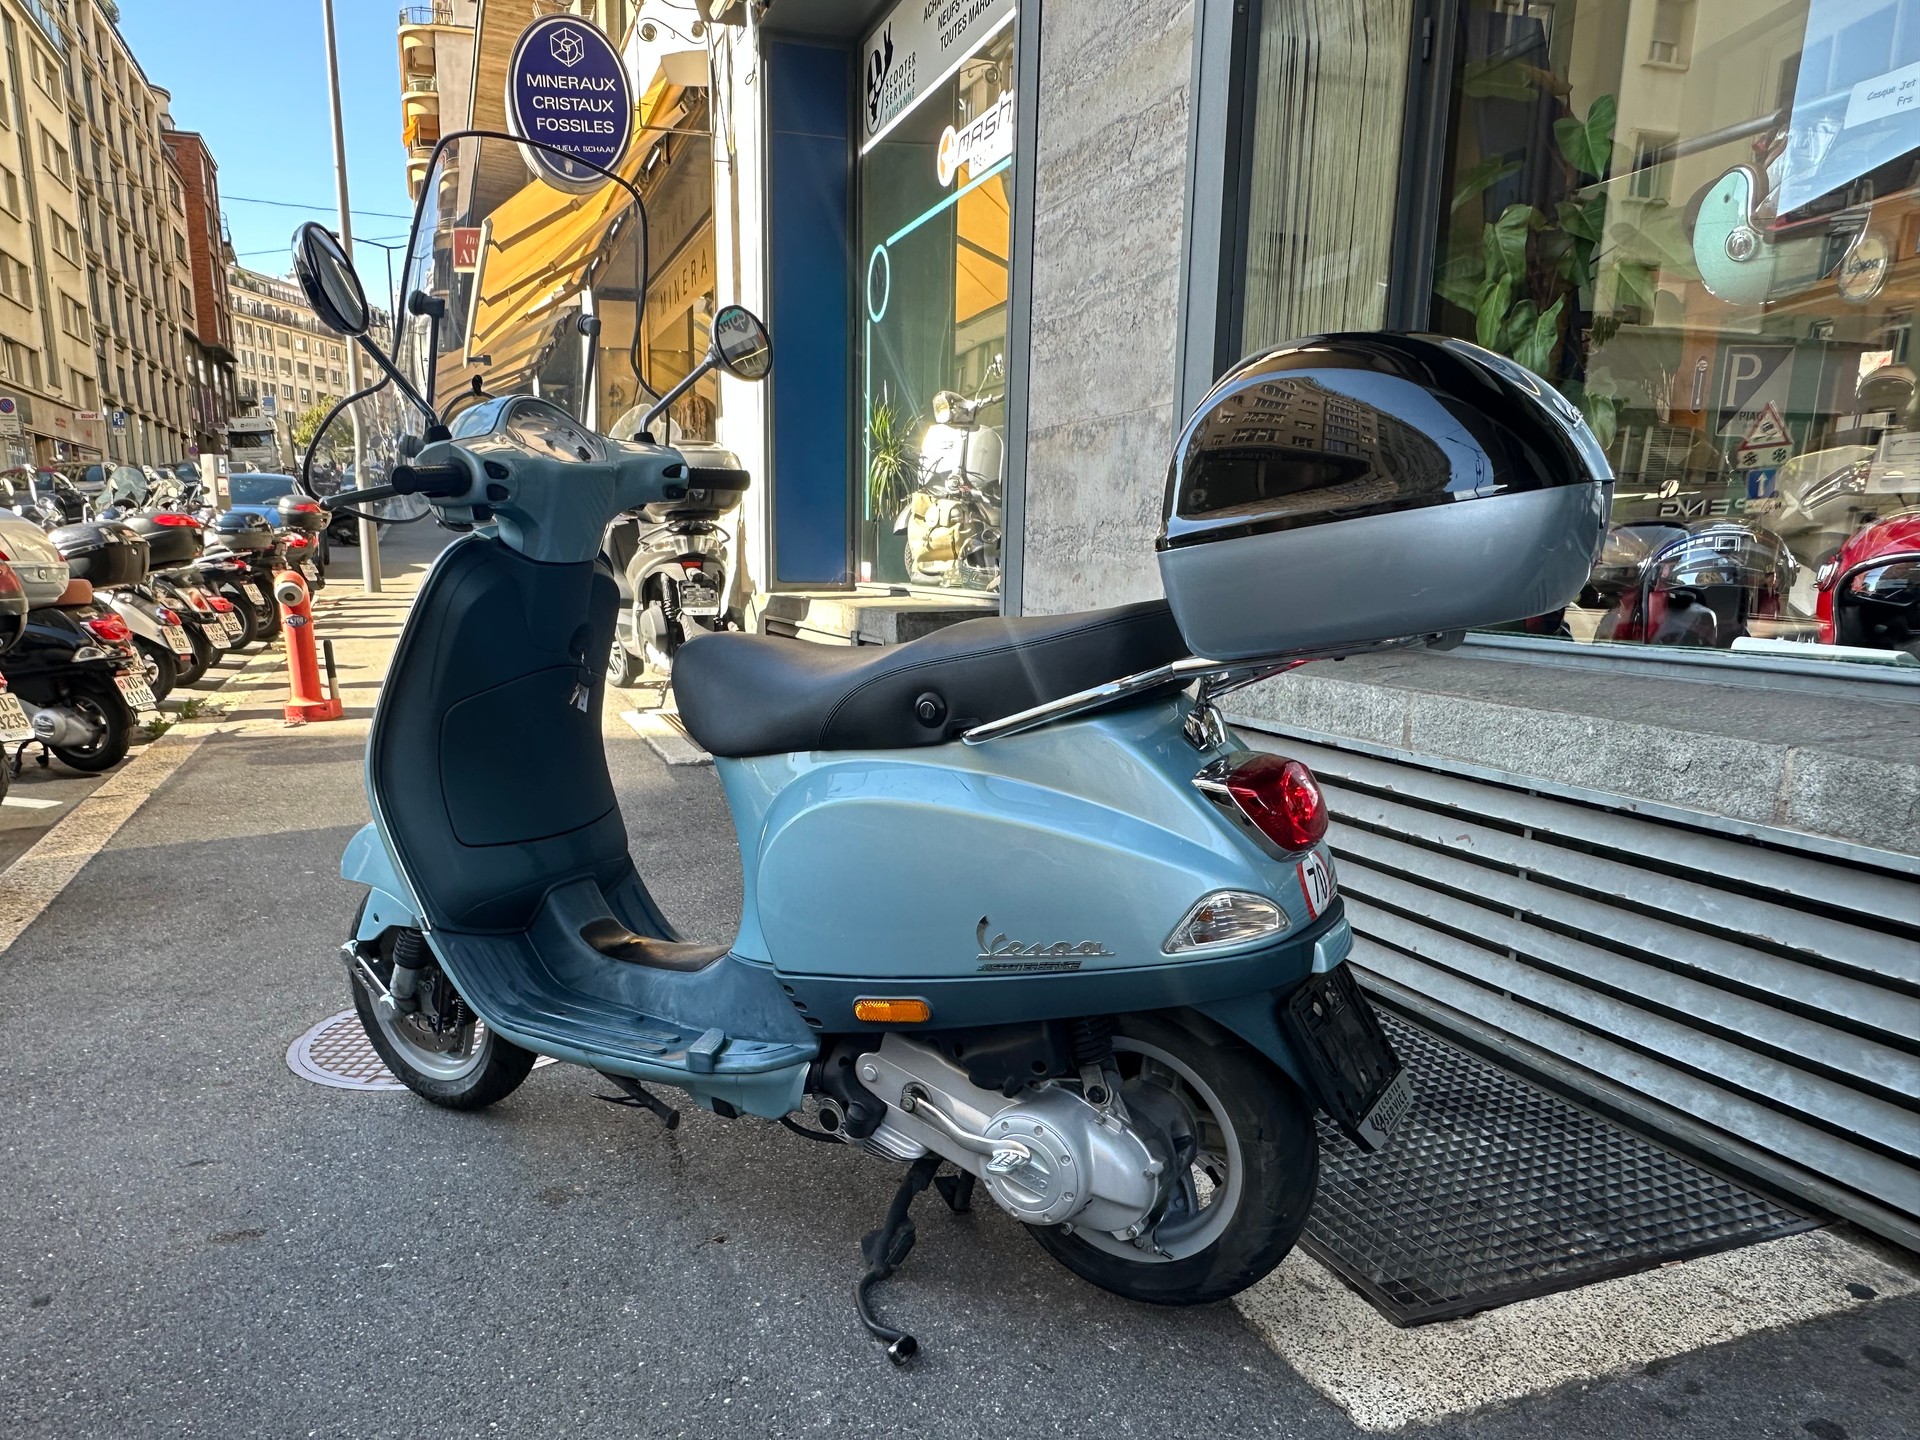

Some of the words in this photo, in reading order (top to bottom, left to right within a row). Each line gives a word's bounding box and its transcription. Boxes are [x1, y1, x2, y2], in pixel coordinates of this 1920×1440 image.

[923, 0, 944, 23] ACHA
[941, 13, 967, 51] TOUTES
[526, 73, 616, 92] MINERAUX
[885, 51, 916, 92] SCOOTER
[885, 69, 916, 109] SERVICE
[532, 96, 615, 113] CRISTAUX
[536, 117, 615, 134] FOSSILES
[1725, 353, 1763, 407] P
[126, 689, 153, 704] 61106
[1306, 862, 1328, 904] 70
[976, 914, 1115, 960] Vespa
[1384, 1089, 1408, 1126] SERVICE
